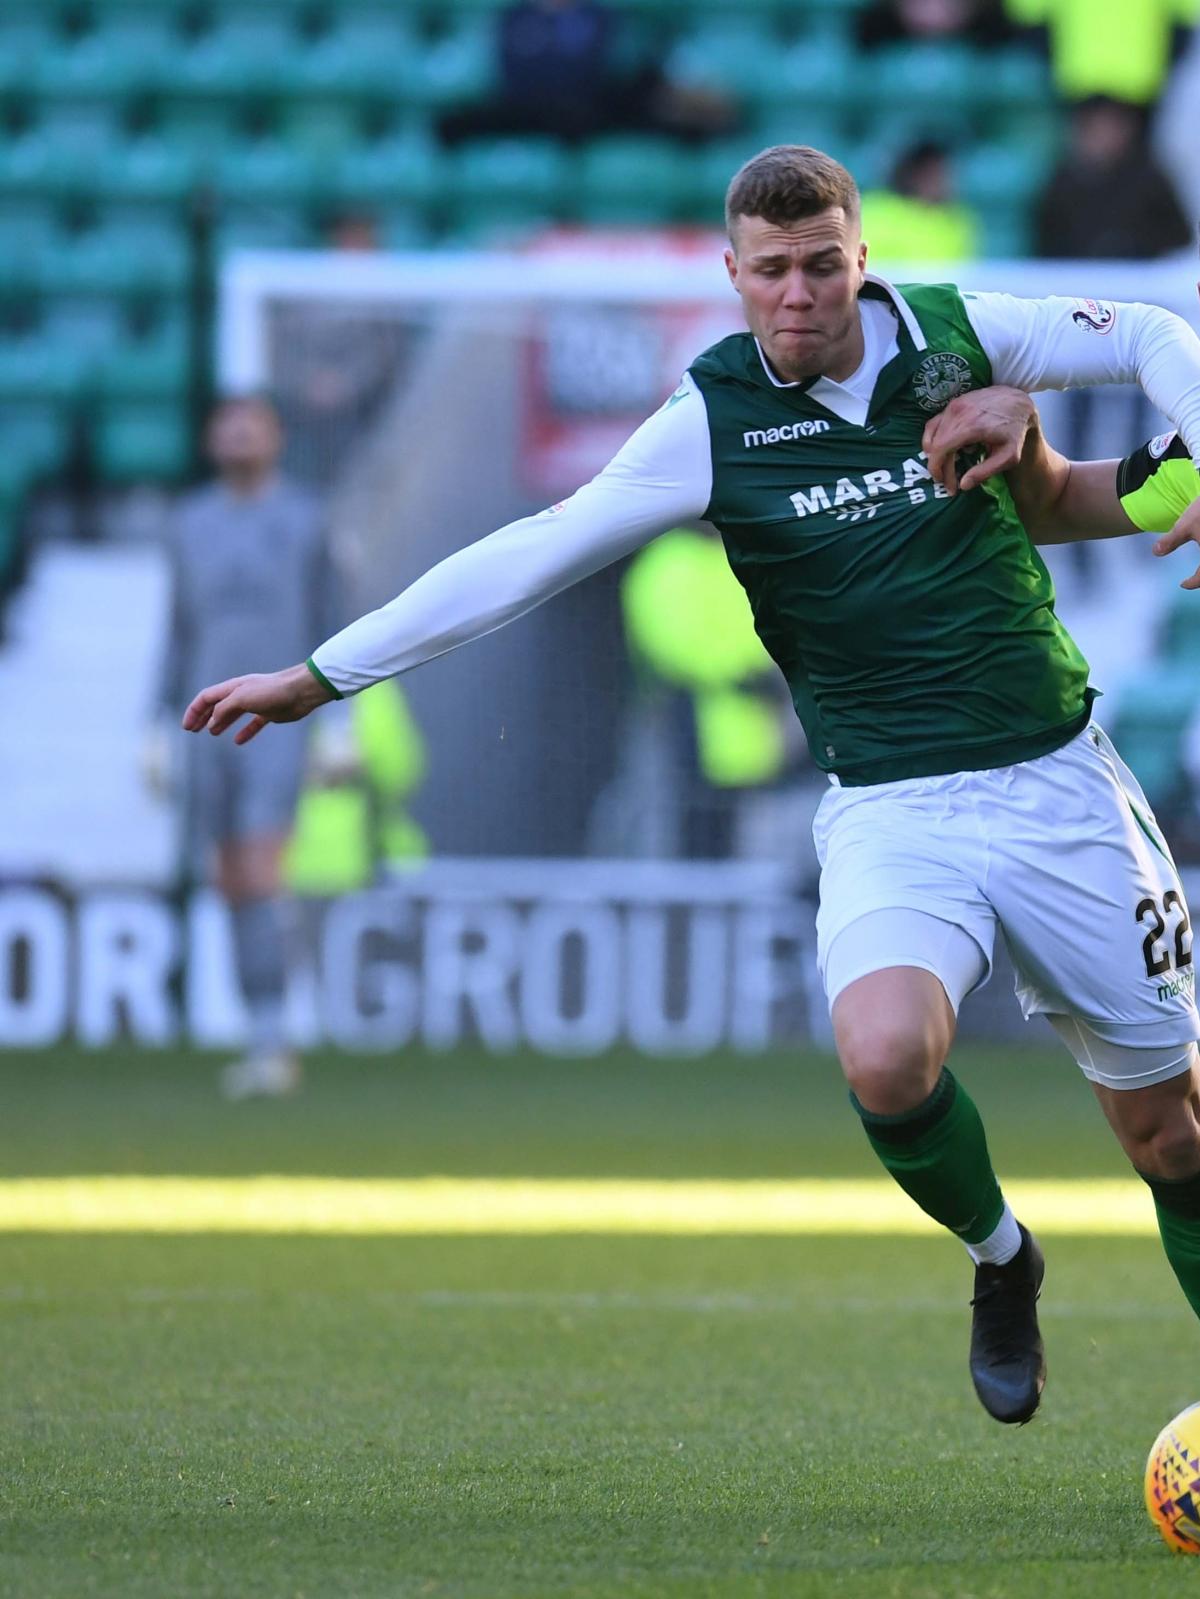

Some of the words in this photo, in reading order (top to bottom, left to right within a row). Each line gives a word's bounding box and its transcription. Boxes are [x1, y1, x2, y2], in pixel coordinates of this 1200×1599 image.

[743, 419, 830, 448] macron
[788, 451, 932, 518] MARA
[908, 482, 953, 505] BE
[1135, 890, 1192, 978] 22
